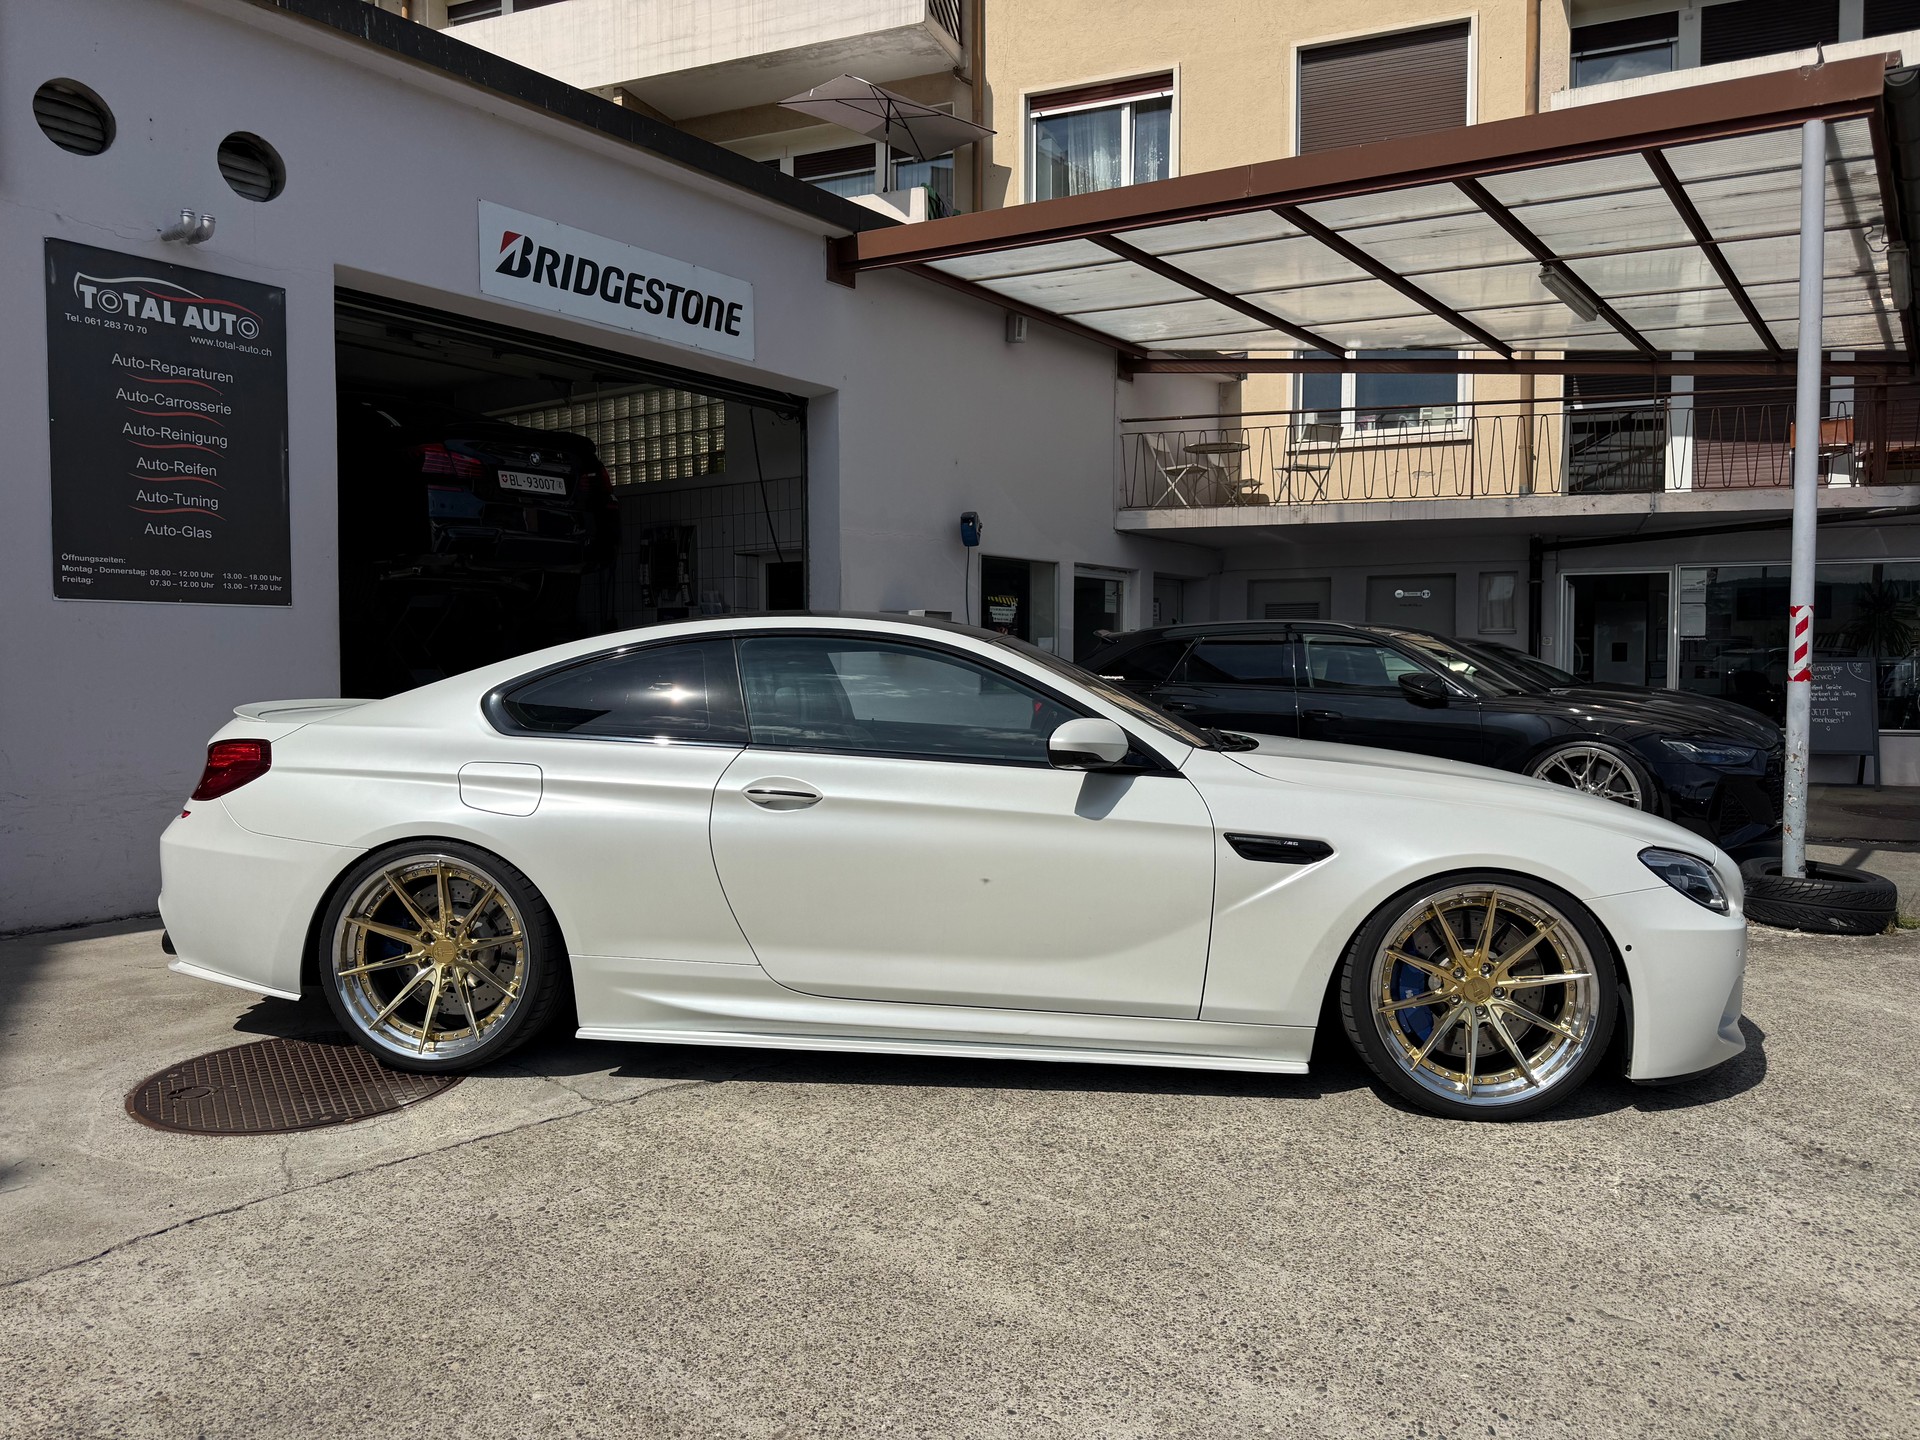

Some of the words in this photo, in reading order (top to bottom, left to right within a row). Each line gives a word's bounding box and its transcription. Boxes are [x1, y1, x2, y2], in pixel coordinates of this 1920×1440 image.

[495, 230, 743, 336] BRIDGESTONE
[79, 284, 176, 325] TOTAL
[182, 305, 260, 340] AUTO
[64, 312, 82, 324] Tel.
[84, 316, 102, 327] 061
[104, 319, 121, 330] 283
[123, 322, 134, 333] 70
[136, 324, 148, 335] 70
[190, 335, 272, 357] www.total-auto.ch
[111, 353, 234, 383] Auto-Reparaturen
[116, 387, 232, 415] Auto-Carrosserie
[122, 422, 228, 449] Auto-Reinigung
[136, 457, 217, 477] Auto-Reifen
[136, 489, 219, 511] Auto-Tuning
[144, 522, 212, 539] Auto-Glas
[61, 553, 126, 564] Öffnungszeiten:
[61, 564, 93, 574] Montag
[99, 566, 148, 577] Donnerstag:
[149, 568, 171, 577] 08.00
[179, 570, 199, 578] 12.00
[201, 571, 215, 579] Uhr
[222, 572, 242, 580] 13.00
[61, 575, 94, 585] Freitag:
[149, 579, 171, 587] 07.30
[179, 580, 199, 588] 12.00
[201, 581, 215, 589] Uhr
[222, 582, 242, 590] 13.00
[269, 584, 283, 592] Uhr
